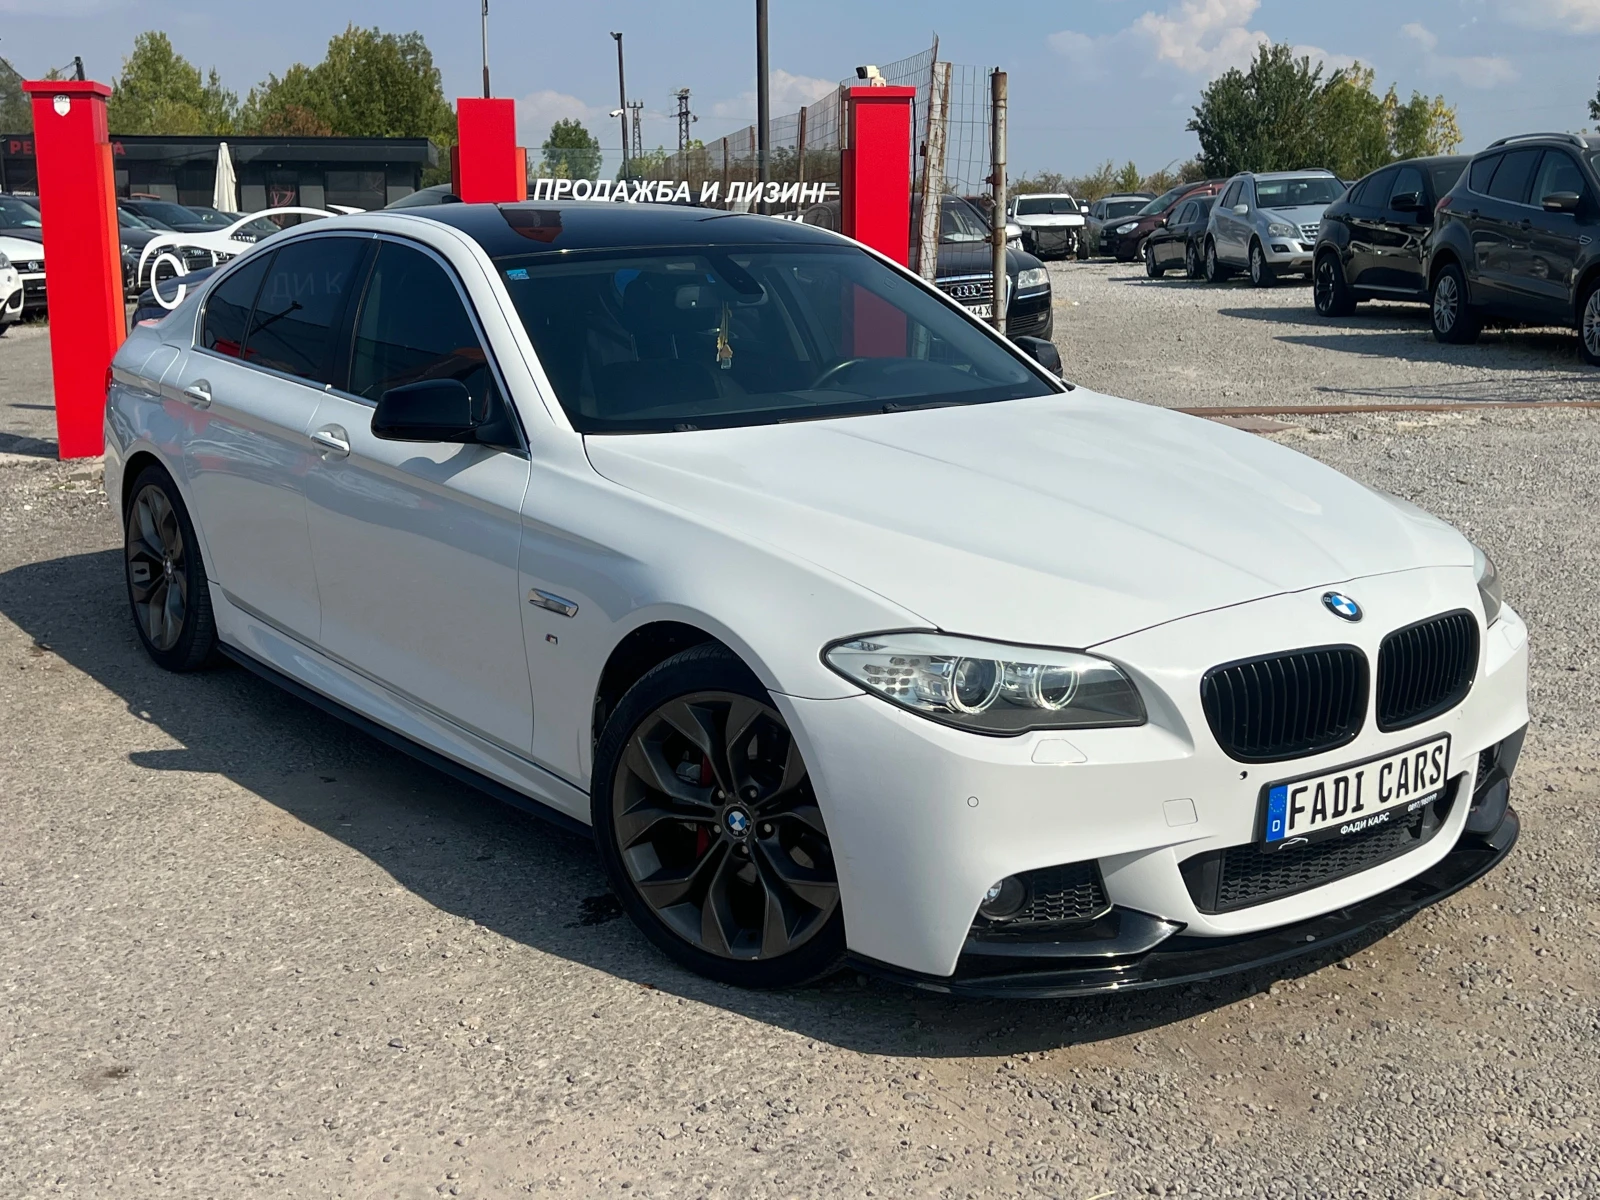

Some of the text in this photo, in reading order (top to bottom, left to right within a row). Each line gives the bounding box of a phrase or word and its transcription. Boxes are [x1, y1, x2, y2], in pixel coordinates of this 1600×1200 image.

[534, 178, 836, 203] ПРОДАЖБА И ЛИЗИНГ
[1272, 745, 1443, 832] D FADI CARS
[1340, 812, 1390, 835] ФАДИ КАРС
